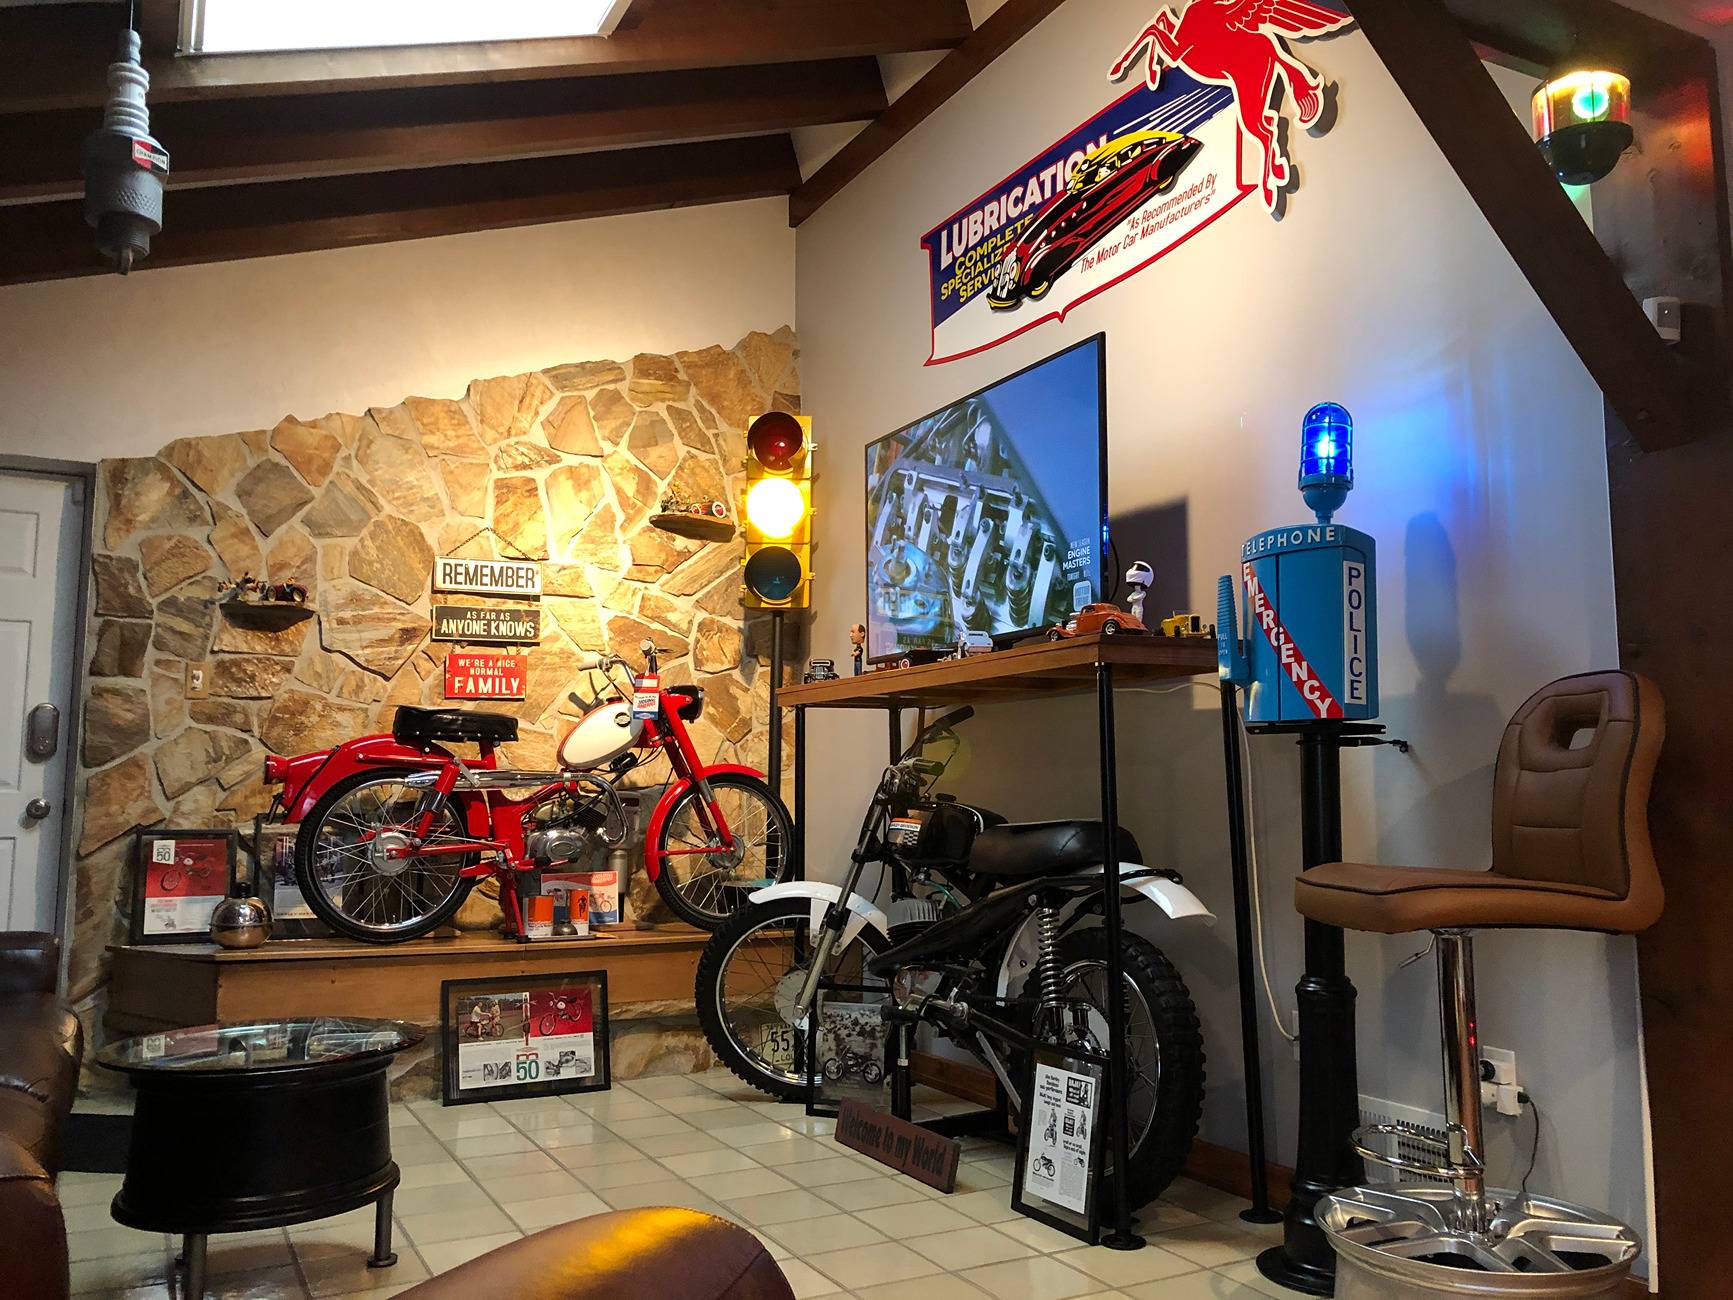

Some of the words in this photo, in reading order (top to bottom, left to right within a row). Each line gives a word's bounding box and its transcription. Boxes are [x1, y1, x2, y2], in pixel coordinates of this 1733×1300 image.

[1141, 178, 1205, 224] Recommended
[1206, 173, 1217, 190] By
[1080, 256, 1094, 274] The
[1096, 241, 1121, 265] Motor
[1122, 232, 1139, 250] Car
[1241, 526, 1335, 557] TELEPHONE
[1062, 556, 1091, 571] MASTERS
[1067, 546, 1091, 560] ENGINE
[442, 562, 536, 589] REMEMBER
[466, 611, 477, 619] AS
[480, 611, 496, 620] FAR
[499, 612, 511, 620] AS
[440, 619, 488, 635] ANYONE
[490, 620, 535, 637] KNOWS
[1348, 566, 1363, 700] POLICE
[1243, 562, 1333, 719] EMERGENCY
[458, 659, 484, 667] WE'RE
[488, 659, 493, 667] A
[469, 667, 504, 676] NORMAL
[454, 676, 520, 694] FAMILY
[156, 851, 171, 862] 50
[771, 1030, 790, 1053] 55
[516, 1060, 540, 1081] 50
[841, 1105, 881, 1148] Welcome
[882, 1125, 894, 1154] to
[895, 1134, 912, 1168] my
[912, 1134, 947, 1176] World
